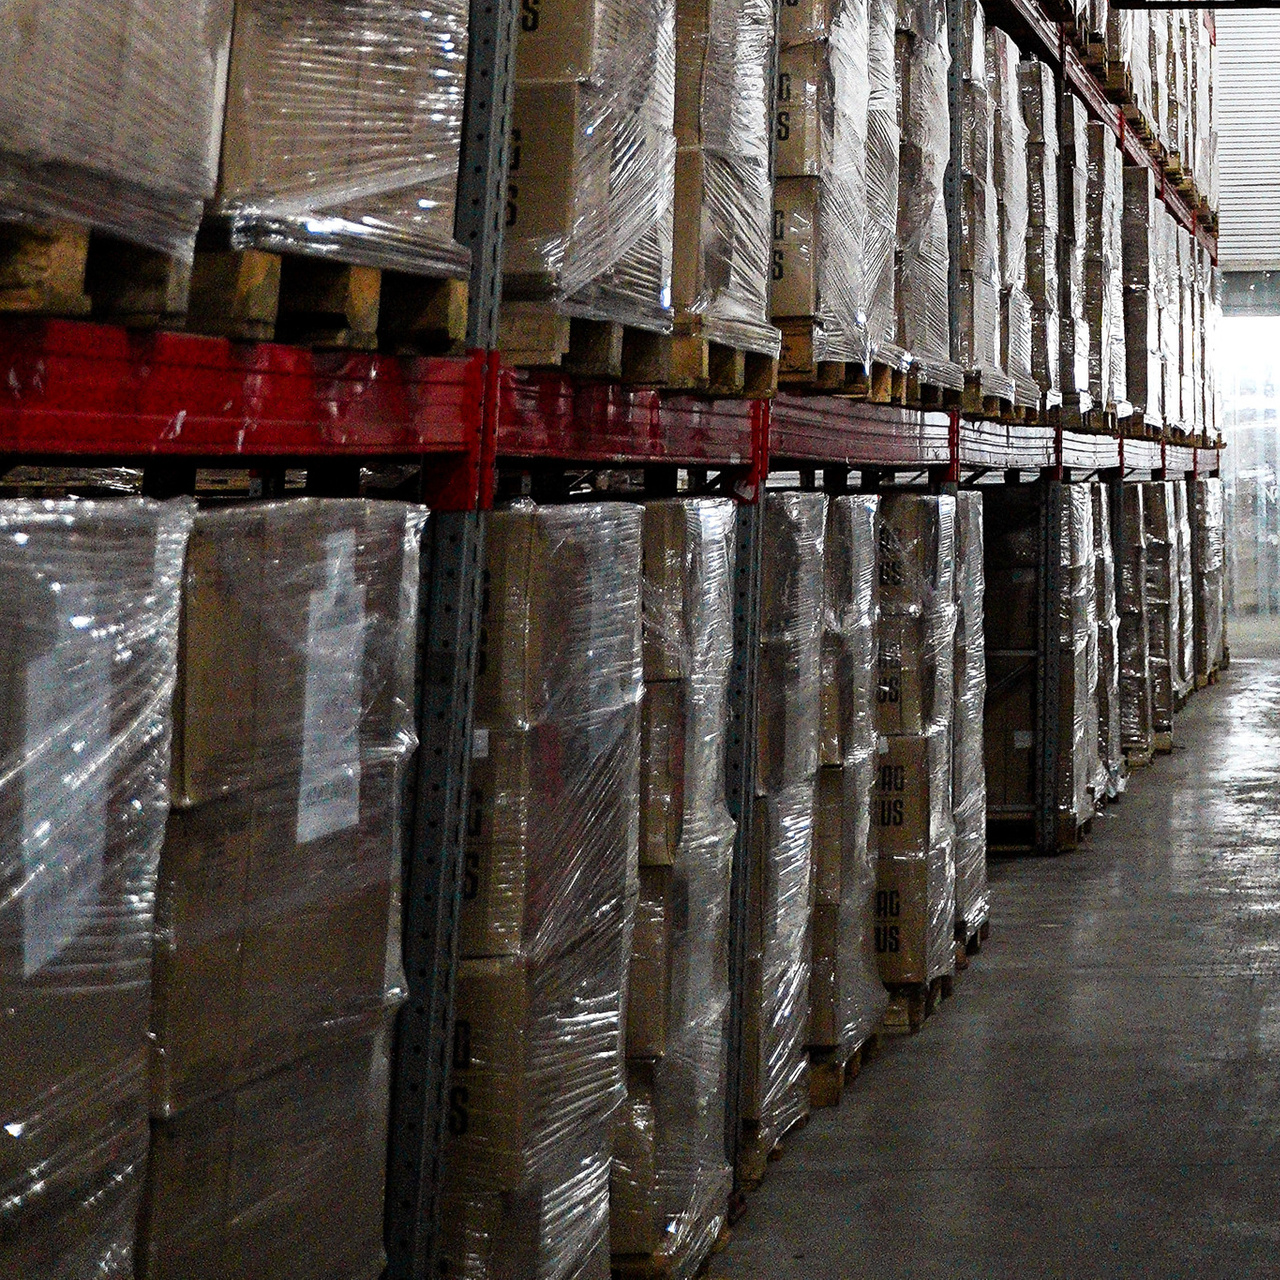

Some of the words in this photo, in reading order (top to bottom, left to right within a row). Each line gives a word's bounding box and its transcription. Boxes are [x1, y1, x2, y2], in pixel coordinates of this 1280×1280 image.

[879, 765, 904, 791] AG
[875, 799, 904, 826] US
[877, 890, 900, 918] AG
[874, 925, 900, 953] US
